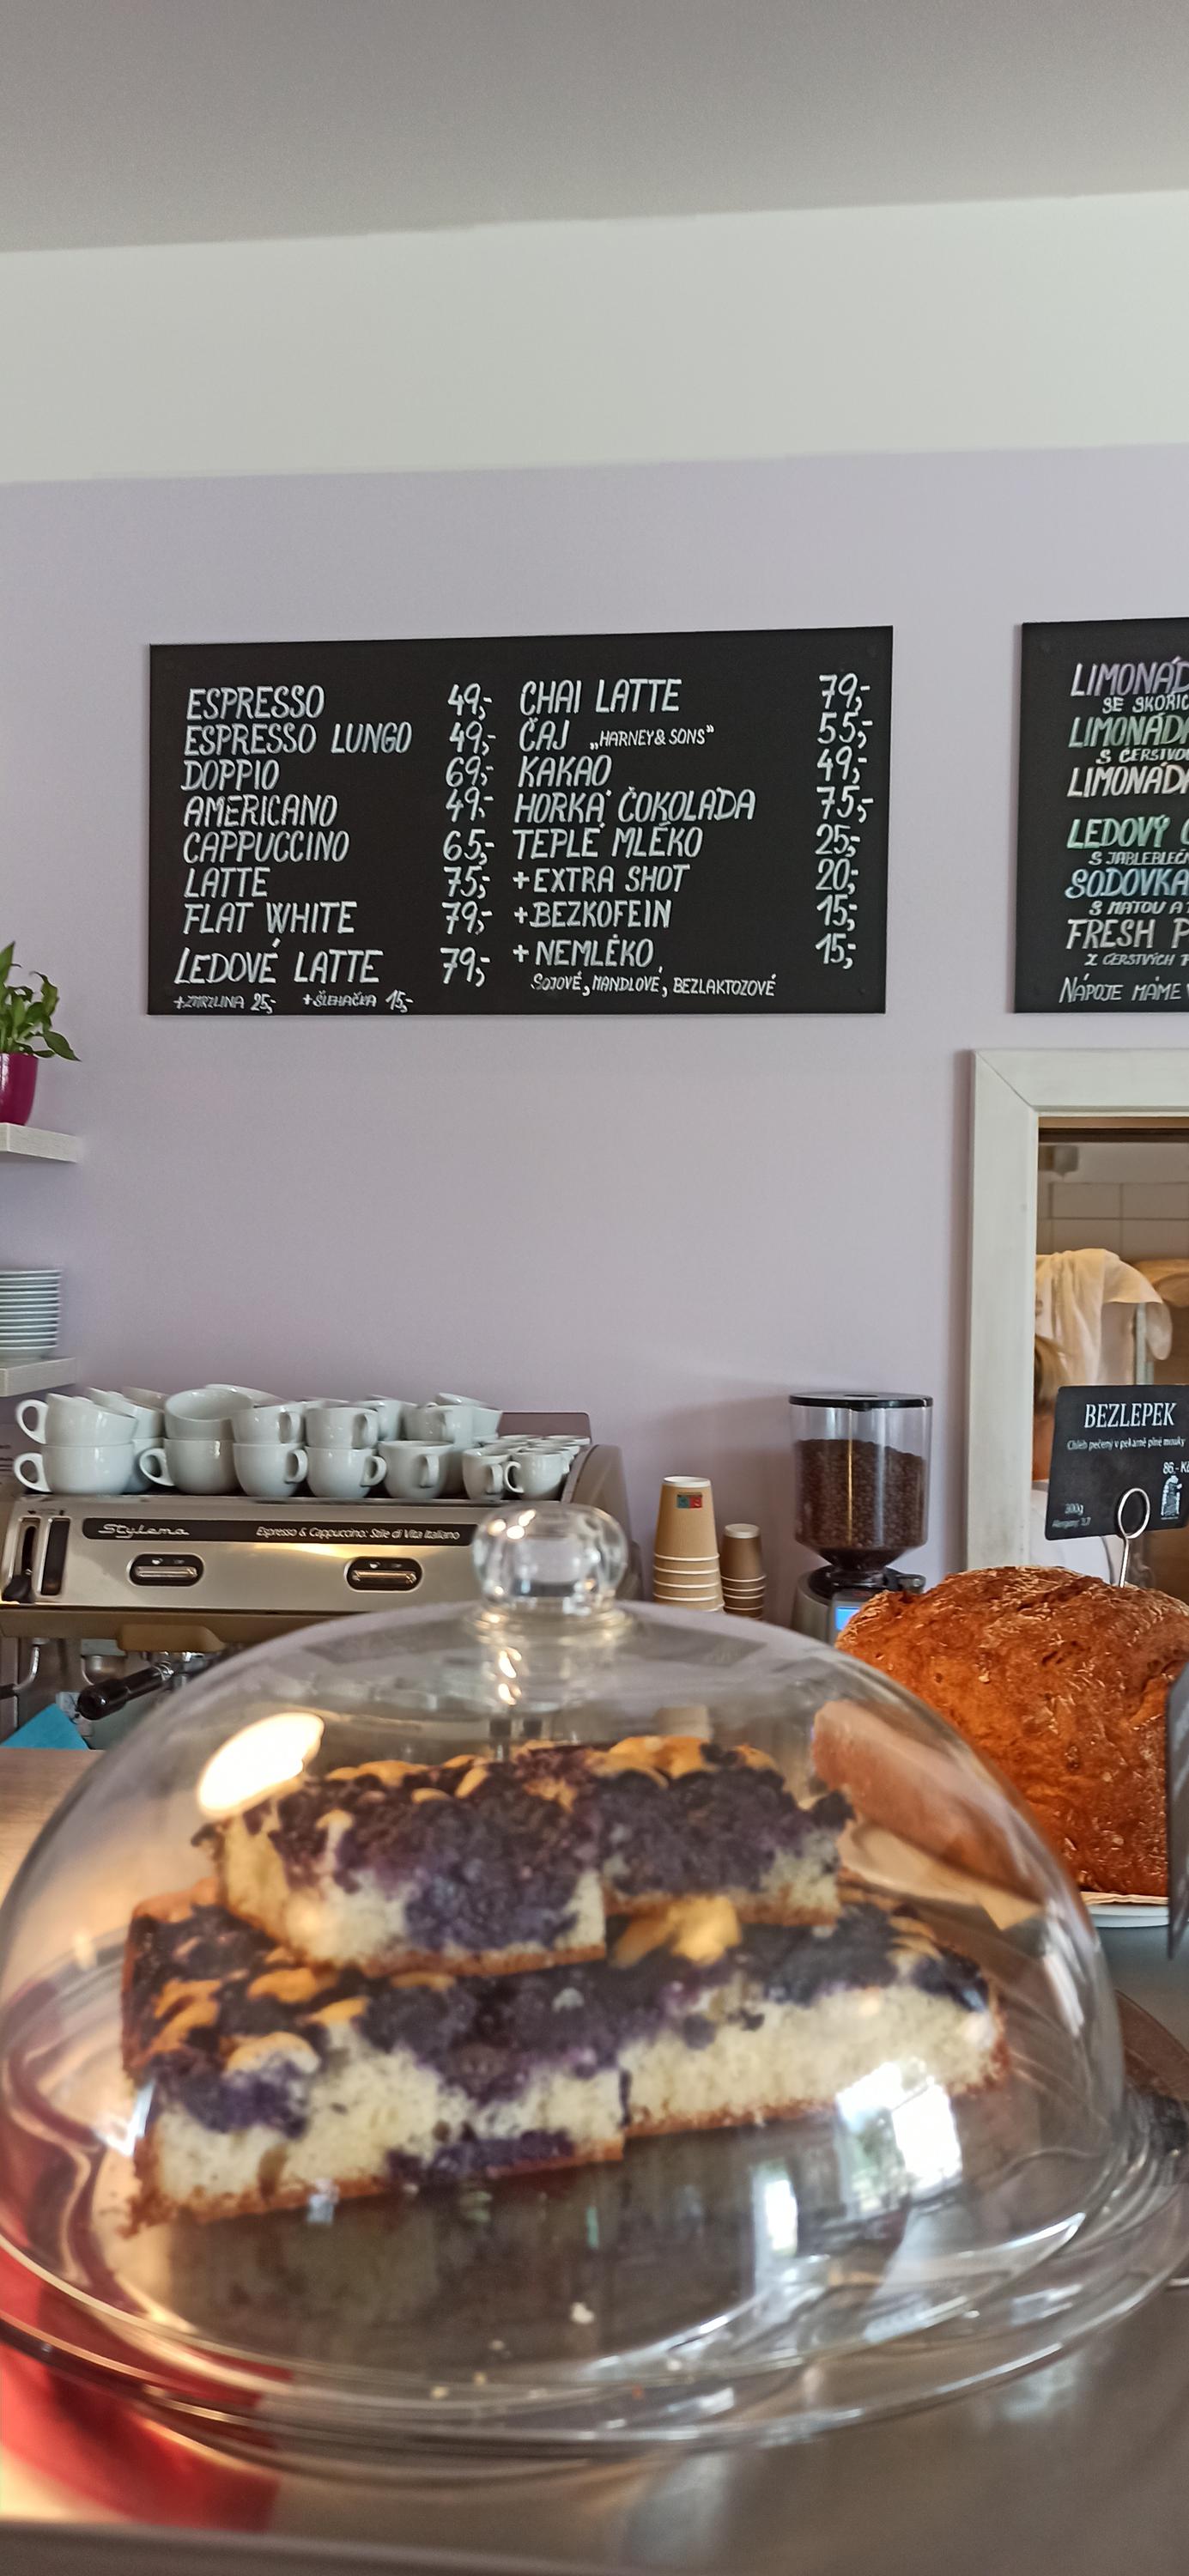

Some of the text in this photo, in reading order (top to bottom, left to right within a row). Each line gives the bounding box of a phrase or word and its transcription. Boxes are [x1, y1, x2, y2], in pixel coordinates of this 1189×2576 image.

[186, 683, 493, 720] ESPRESSO 49,-
[519, 673, 871, 716] CHAI LATTE 79,-
[1102, 696, 1125, 714] SE
[184, 720, 496, 756] ESPRESSO LUNGO 49,-
[519, 716, 570, 752] ČAJ
[817, 712, 874, 749] 55,-
[180, 756, 494, 791] DOPPIO 69,-
[518, 748, 868, 787] KAKAO 49,-
[183, 786, 494, 828] AMERICANO 49,-
[816, 786, 874, 823] 75,-
[183, 829, 495, 865] CAPPUCCINO 65,-
[611, 821, 704, 859] MLÉKO
[815, 823, 861, 858] 25,-
[1066, 814, 1171, 848] LEDOVÝ
[183, 866, 491, 899] LATTE 75,-
[625, 864, 691, 892] SHOT
[815, 859, 859, 893] 20,-
[183, 900, 494, 936] FLAT WHITE 79,-
[816, 895, 858, 931] 15,-
[1168, 901, 1184, 914] A
[815, 933, 857, 969] 15,-
[1065, 918, 1156, 950] FRESH
[173, 938, 491, 987] LEDOVÉ LATTE 79,-
[1084, 1402, 1177, 1429] BEZLEPEK
